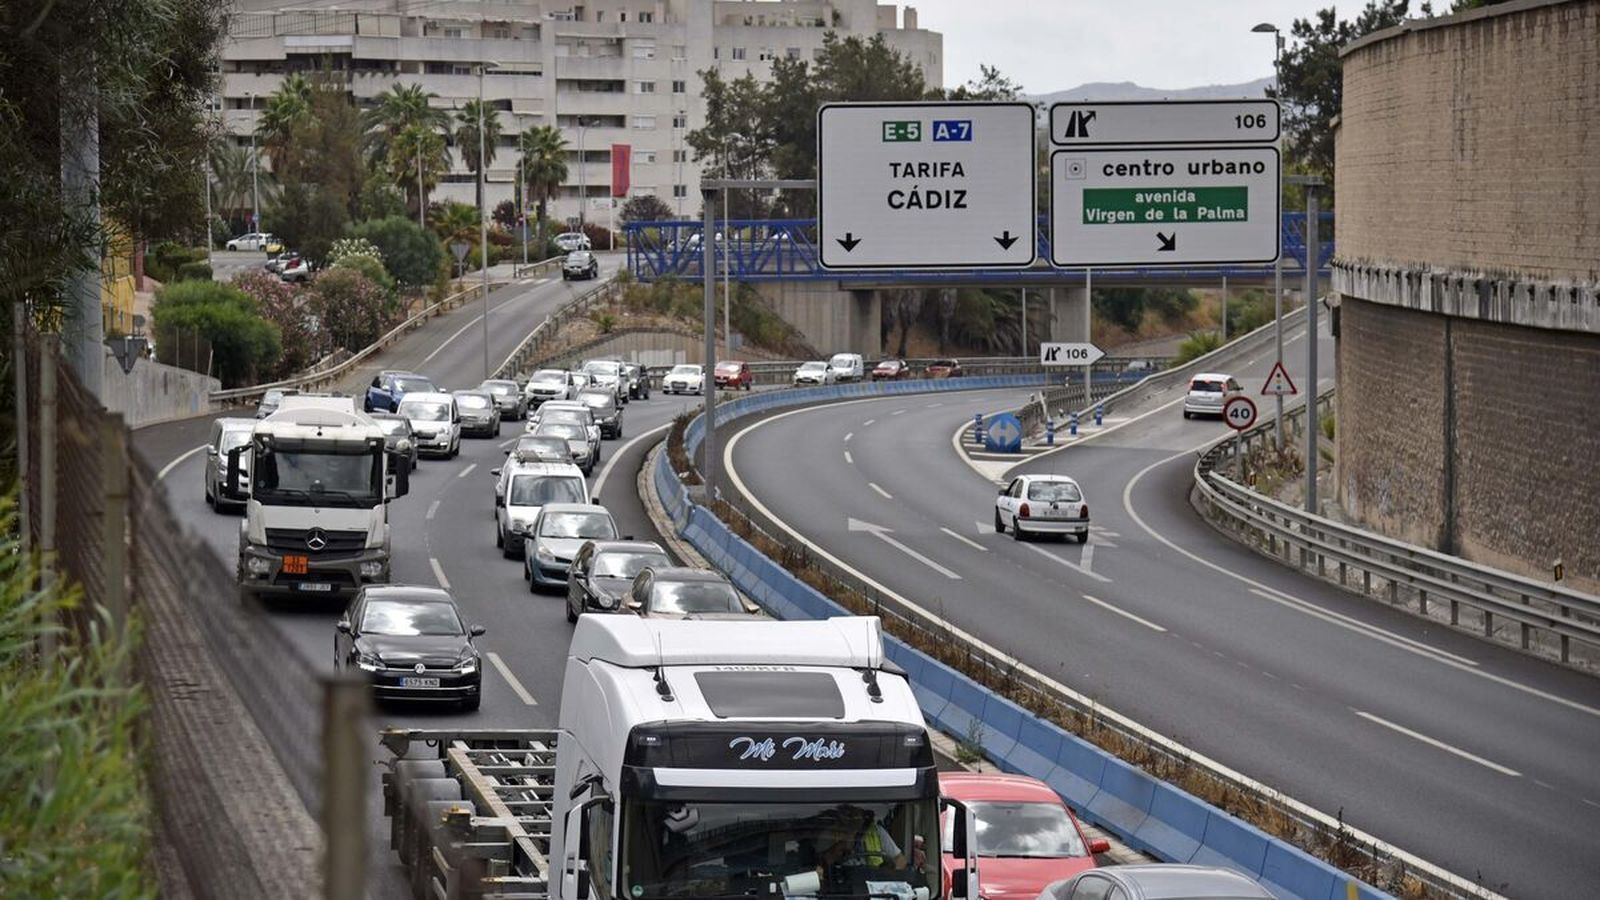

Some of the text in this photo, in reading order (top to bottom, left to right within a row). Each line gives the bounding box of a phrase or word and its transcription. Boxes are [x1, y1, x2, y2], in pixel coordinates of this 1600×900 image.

[1235, 114, 1266, 128] 106
[884, 123, 919, 139] E-5
[936, 123, 970, 139] A-7
[889, 162, 965, 178] TARIFA
[1102, 159, 1265, 176] centro urbano
[887, 185, 967, 209] CÁDIZ
[1135, 190, 1195, 203] avenida
[1086, 206, 1245, 223] Virgen de la Palma
[1067, 349, 1088, 359] 106
[1230, 408, 1250, 419] 40
[729, 737, 845, 761] Mi Mari
